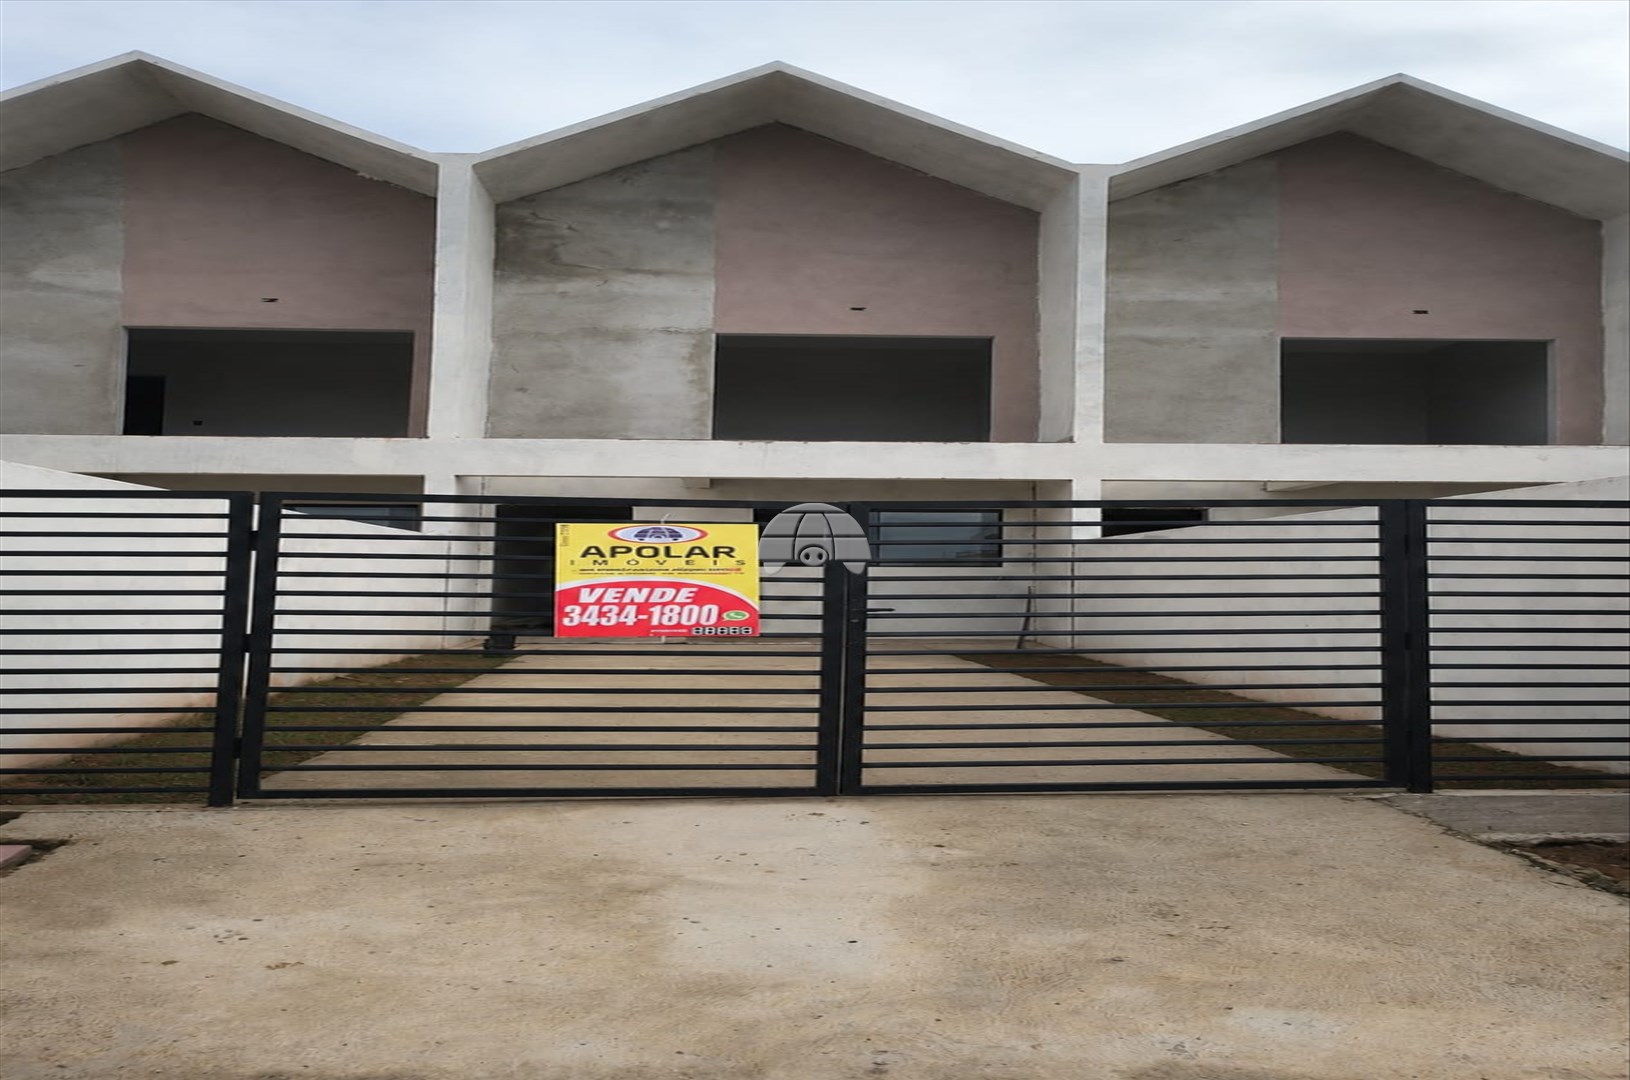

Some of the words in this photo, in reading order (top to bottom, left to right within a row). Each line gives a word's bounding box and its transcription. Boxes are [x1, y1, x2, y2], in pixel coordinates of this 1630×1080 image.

[580, 546, 736, 558] APOLAR
[570, 558, 746, 566] IMÓVEIS
[578, 587, 698, 603] VENDE
[562, 604, 719, 626] 3434-1800
